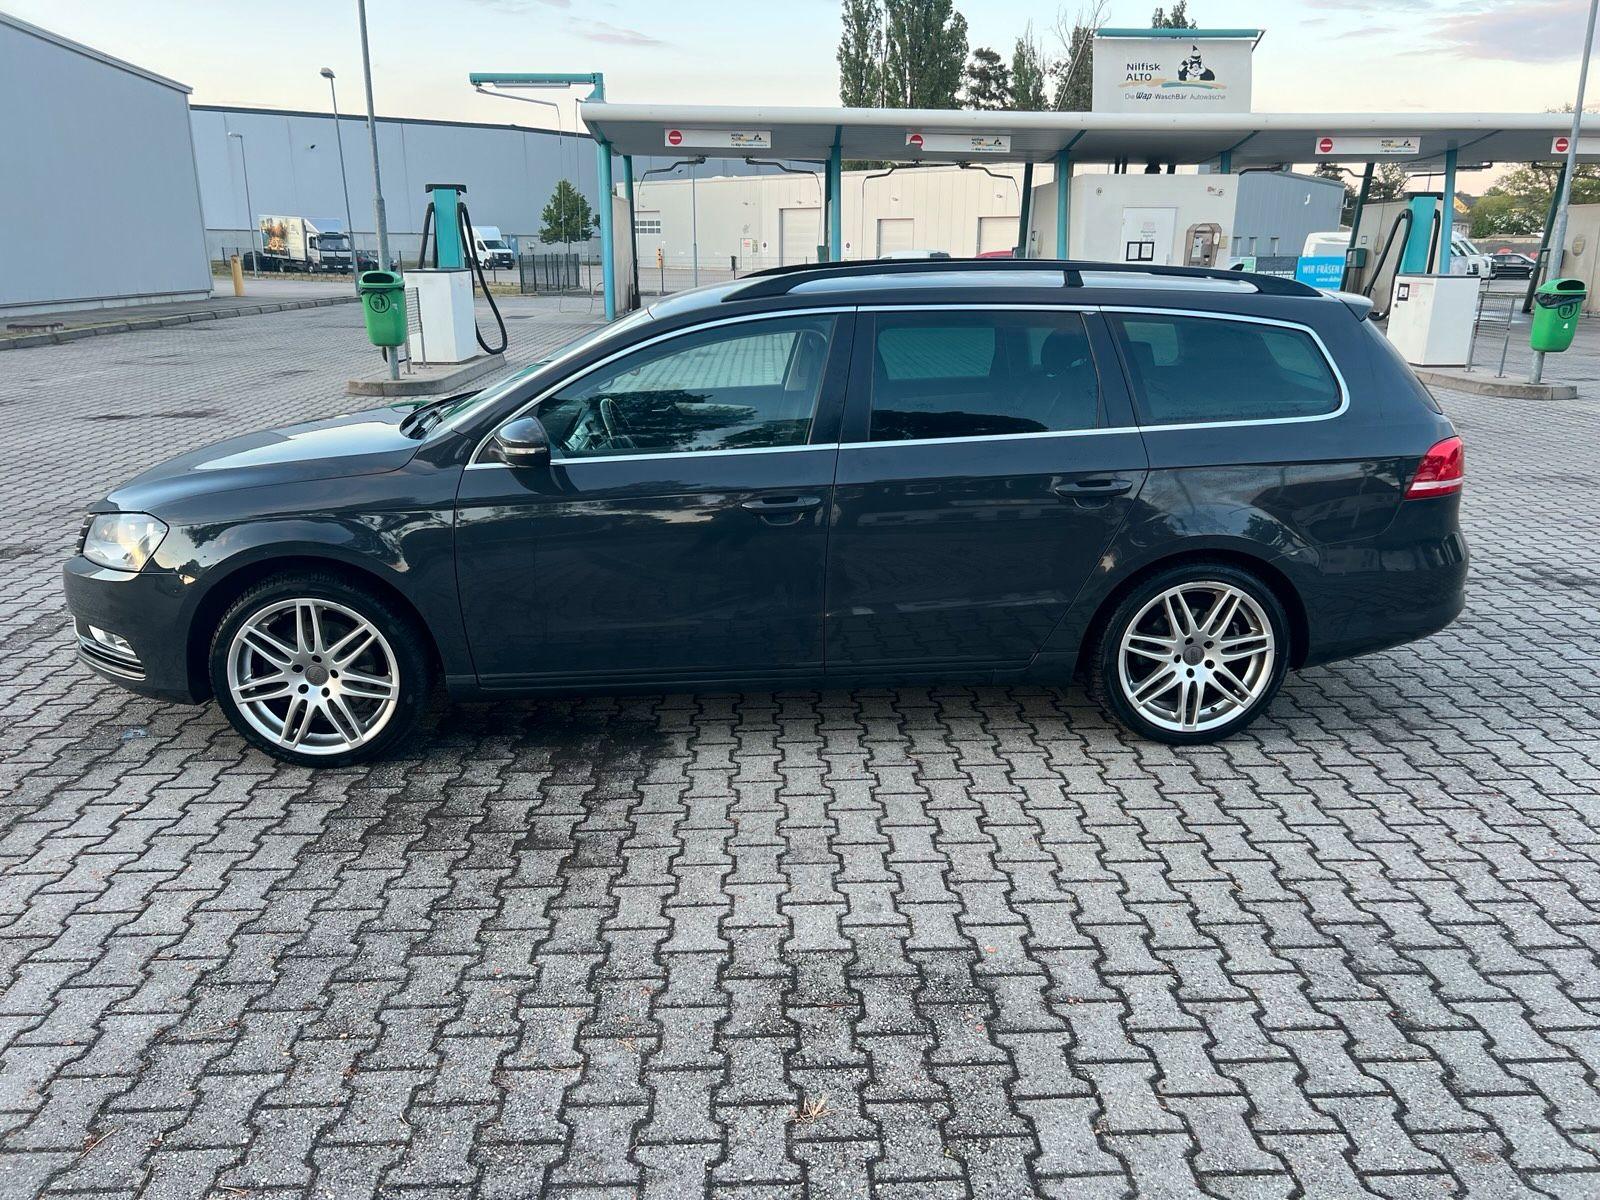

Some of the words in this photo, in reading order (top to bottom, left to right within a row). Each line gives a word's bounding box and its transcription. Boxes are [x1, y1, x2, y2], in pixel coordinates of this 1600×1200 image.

[1126, 62, 1161, 71] Nilfisk
[1126, 73, 1152, 81] ALTO
[1136, 91, 1153, 101] Wap
[1303, 265, 1315, 274] WIR
